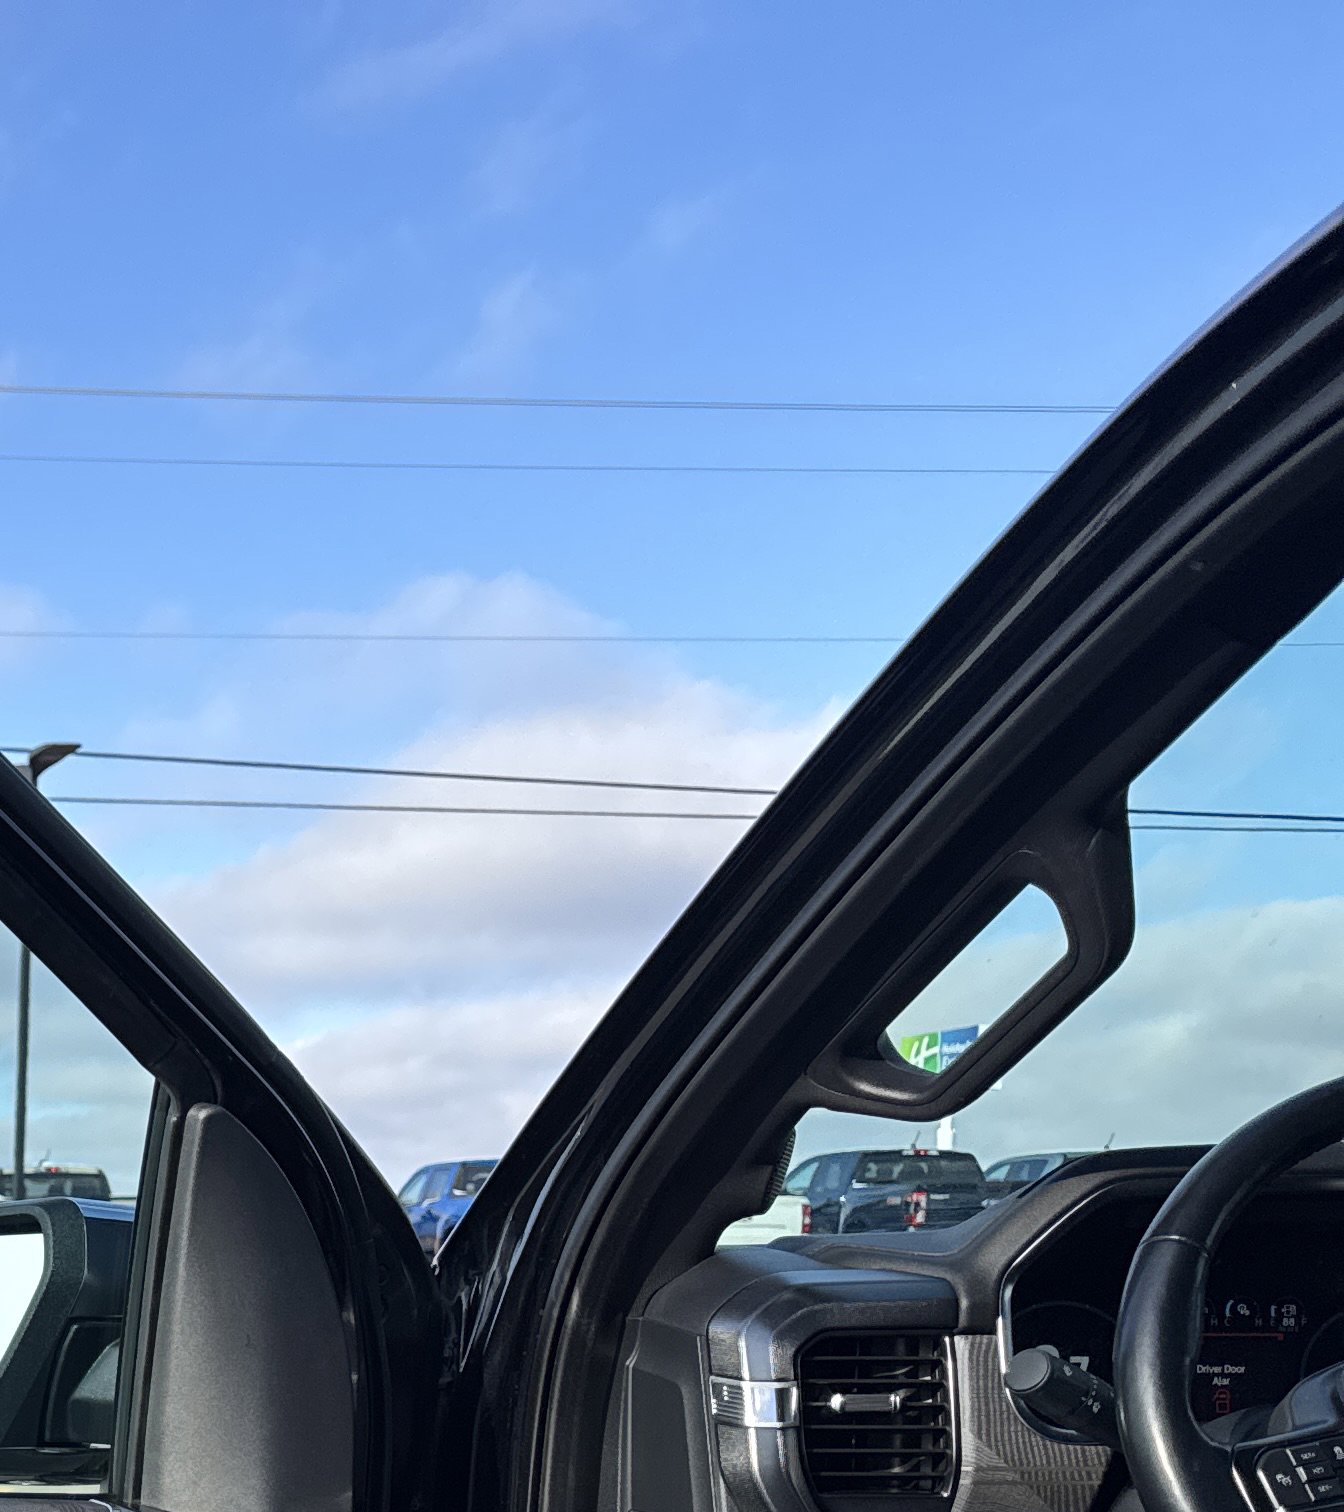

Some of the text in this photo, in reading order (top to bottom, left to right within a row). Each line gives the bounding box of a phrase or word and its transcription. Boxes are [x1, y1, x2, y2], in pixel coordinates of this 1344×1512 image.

[1196, 1364, 1246, 1374] Driver Door
[1212, 1376, 1231, 1386] Ajar
